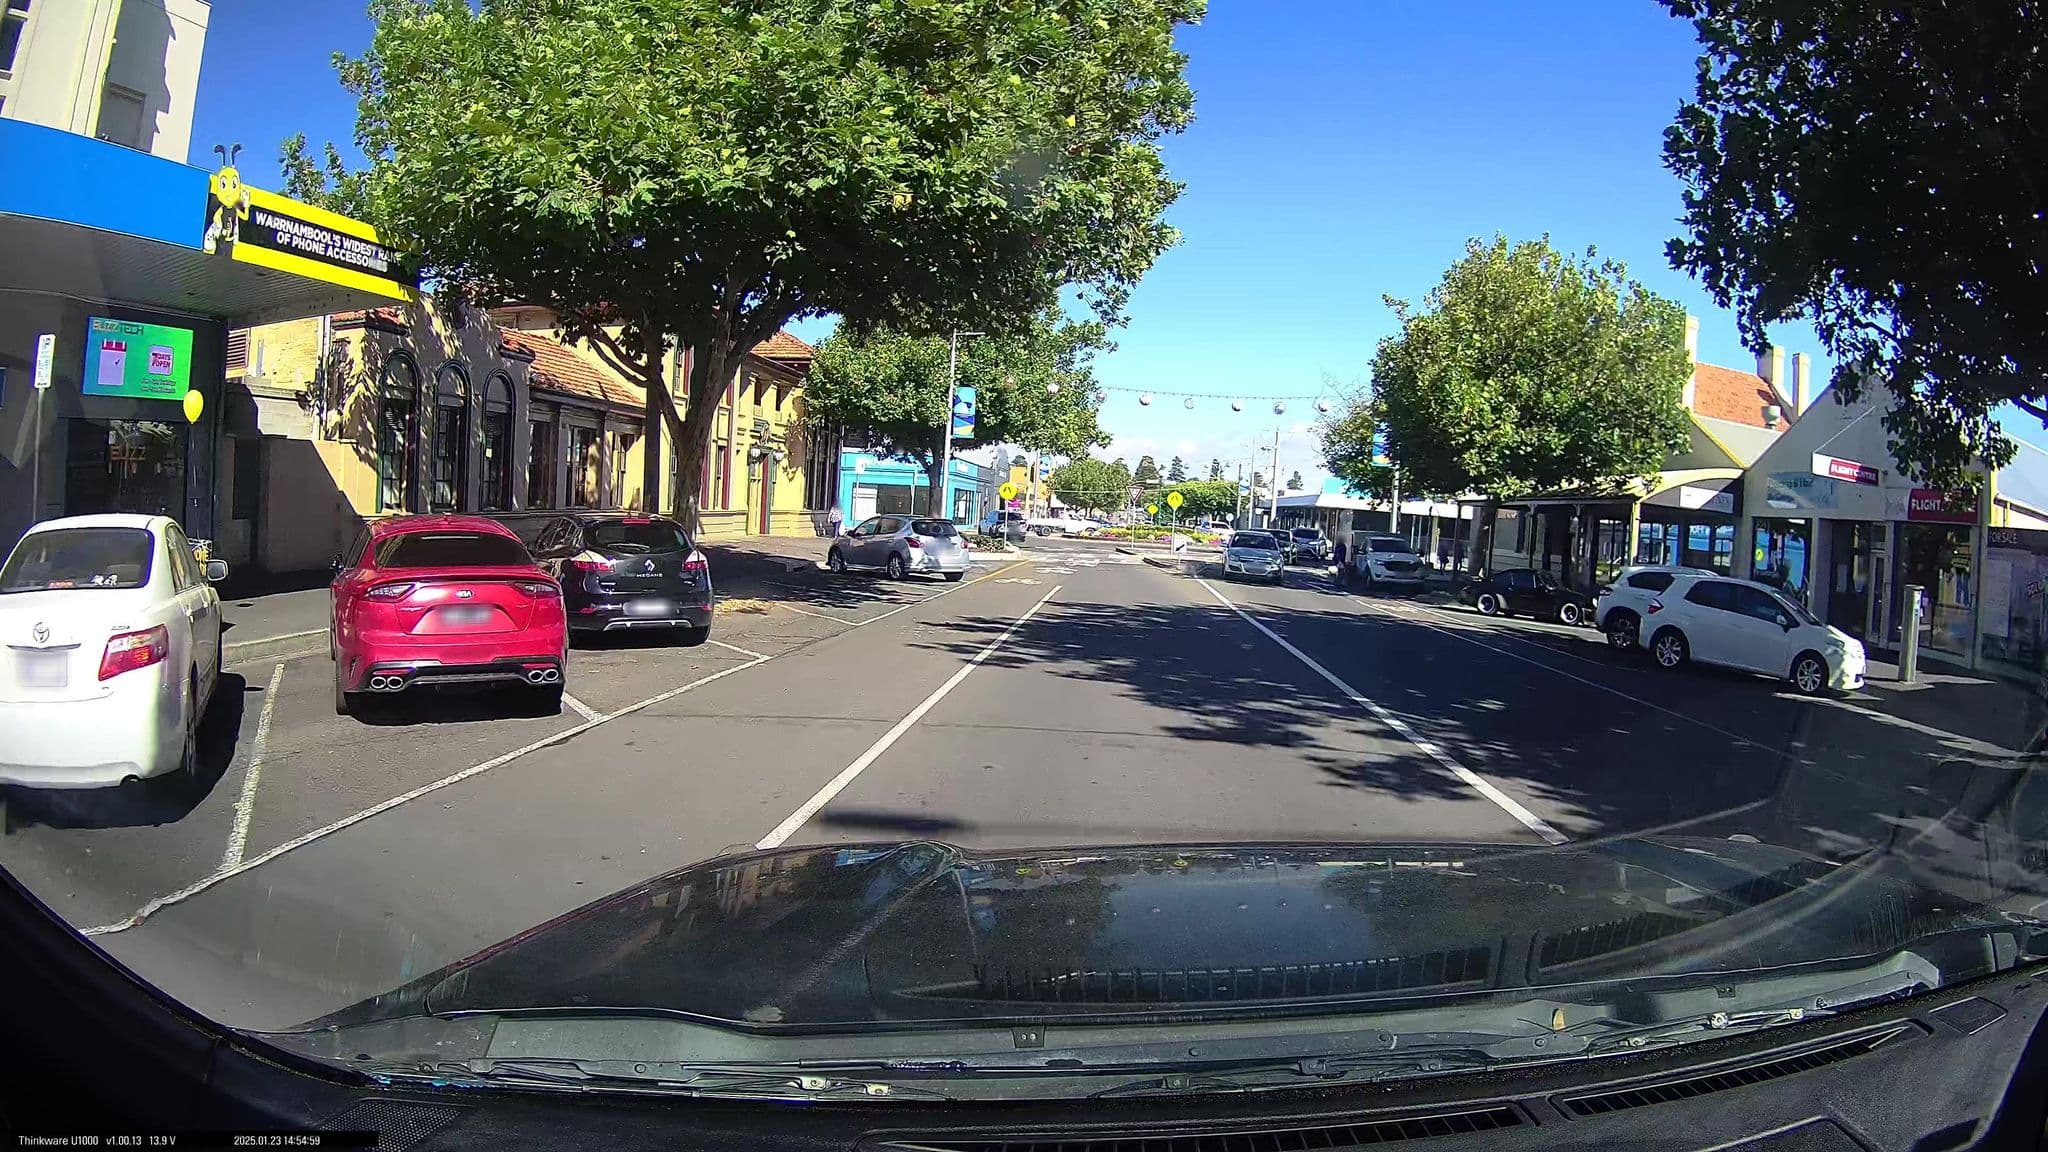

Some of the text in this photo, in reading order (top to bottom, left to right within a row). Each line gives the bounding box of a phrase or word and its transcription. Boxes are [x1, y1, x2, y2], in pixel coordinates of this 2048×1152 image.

[255, 211, 342, 247] WARRNAMBOOL'S
[342, 236, 378, 257] WIDEST
[276, 231, 290, 244] OF
[292, 235, 326, 255] PHONE
[151, 352, 171, 366] 7 DAYS
[156, 360, 171, 368] OPEN
[1911, 499, 1941, 512] FLIGHT
